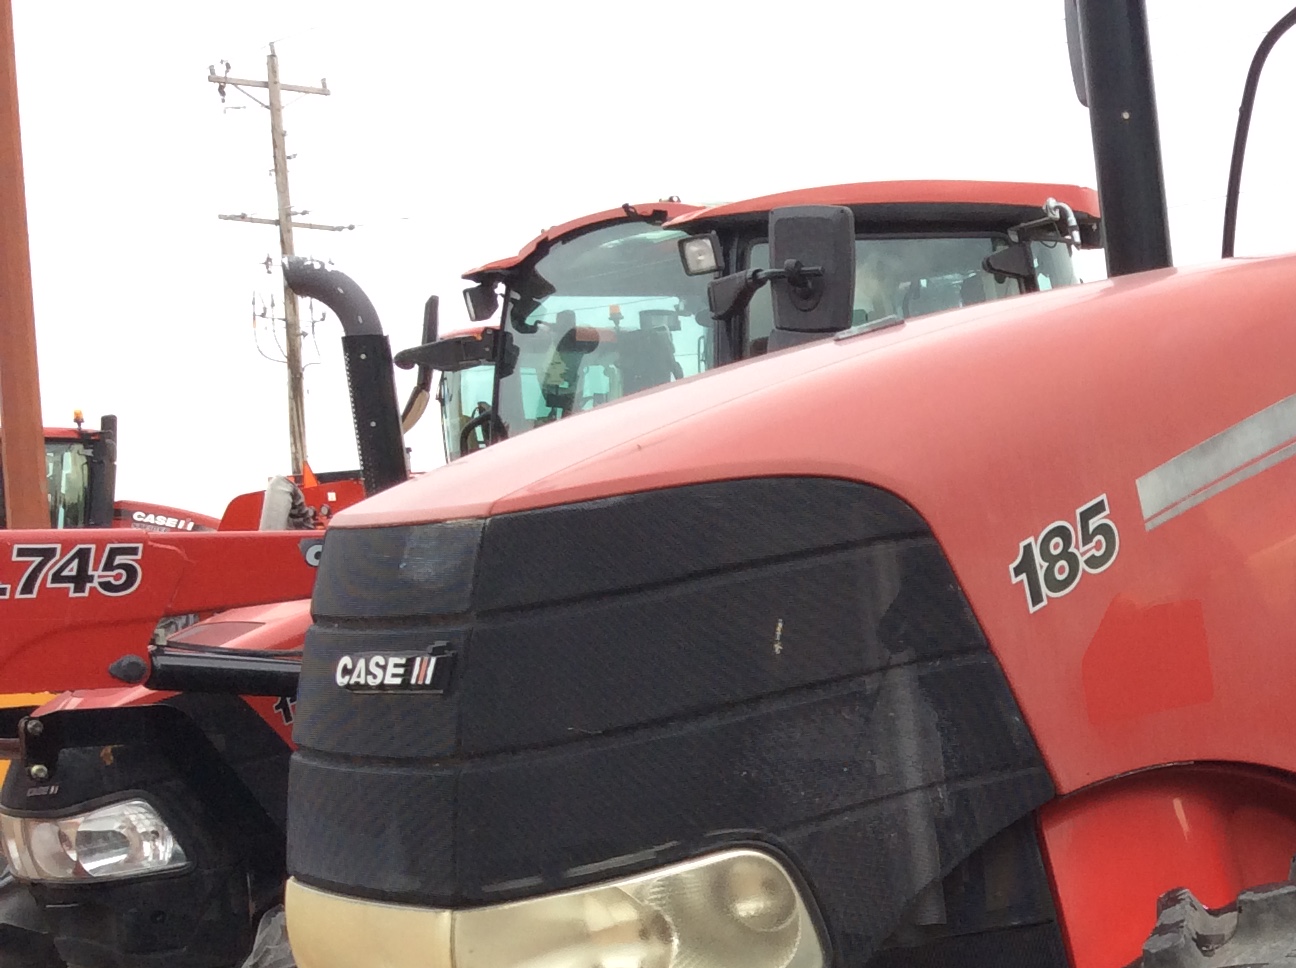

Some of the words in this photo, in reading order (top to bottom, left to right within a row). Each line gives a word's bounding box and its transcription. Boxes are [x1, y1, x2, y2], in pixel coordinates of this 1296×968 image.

[132, 511, 179, 528] CASE
[1009, 493, 1119, 614] 185
[336, 655, 407, 687] CASE
